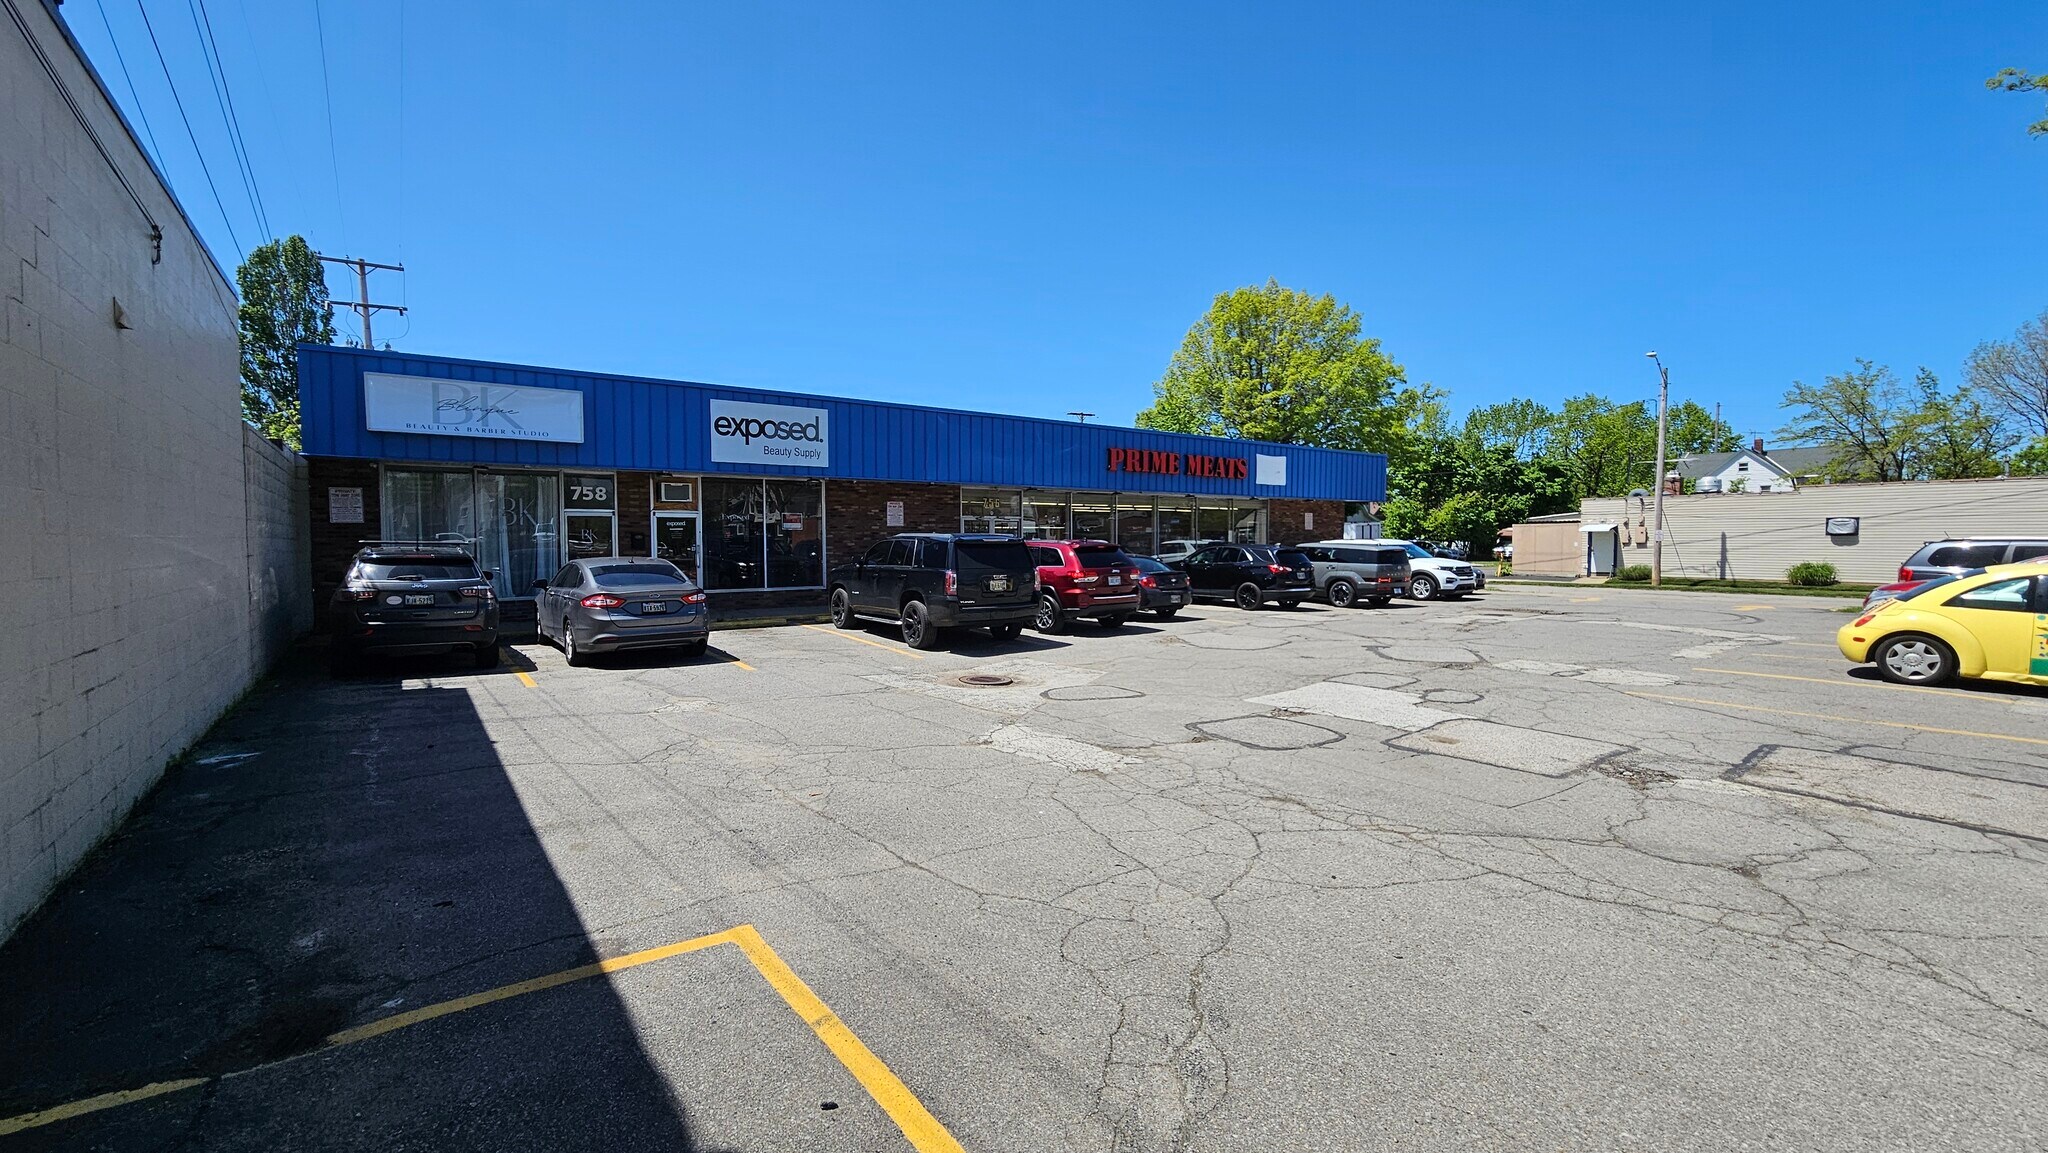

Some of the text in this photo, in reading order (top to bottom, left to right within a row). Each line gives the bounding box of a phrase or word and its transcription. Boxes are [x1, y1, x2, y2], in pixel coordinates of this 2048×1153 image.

[405, 422, 449, 431] BEAUTY
[466, 426, 506, 435] BARBER
[511, 429, 550, 437] STUDIO
[763, 445, 821, 460] Beauty Supply
[1108, 447, 1248, 480] PRIME MEATS
[570, 486, 607, 501] 758
[983, 498, 1000, 509] 756
